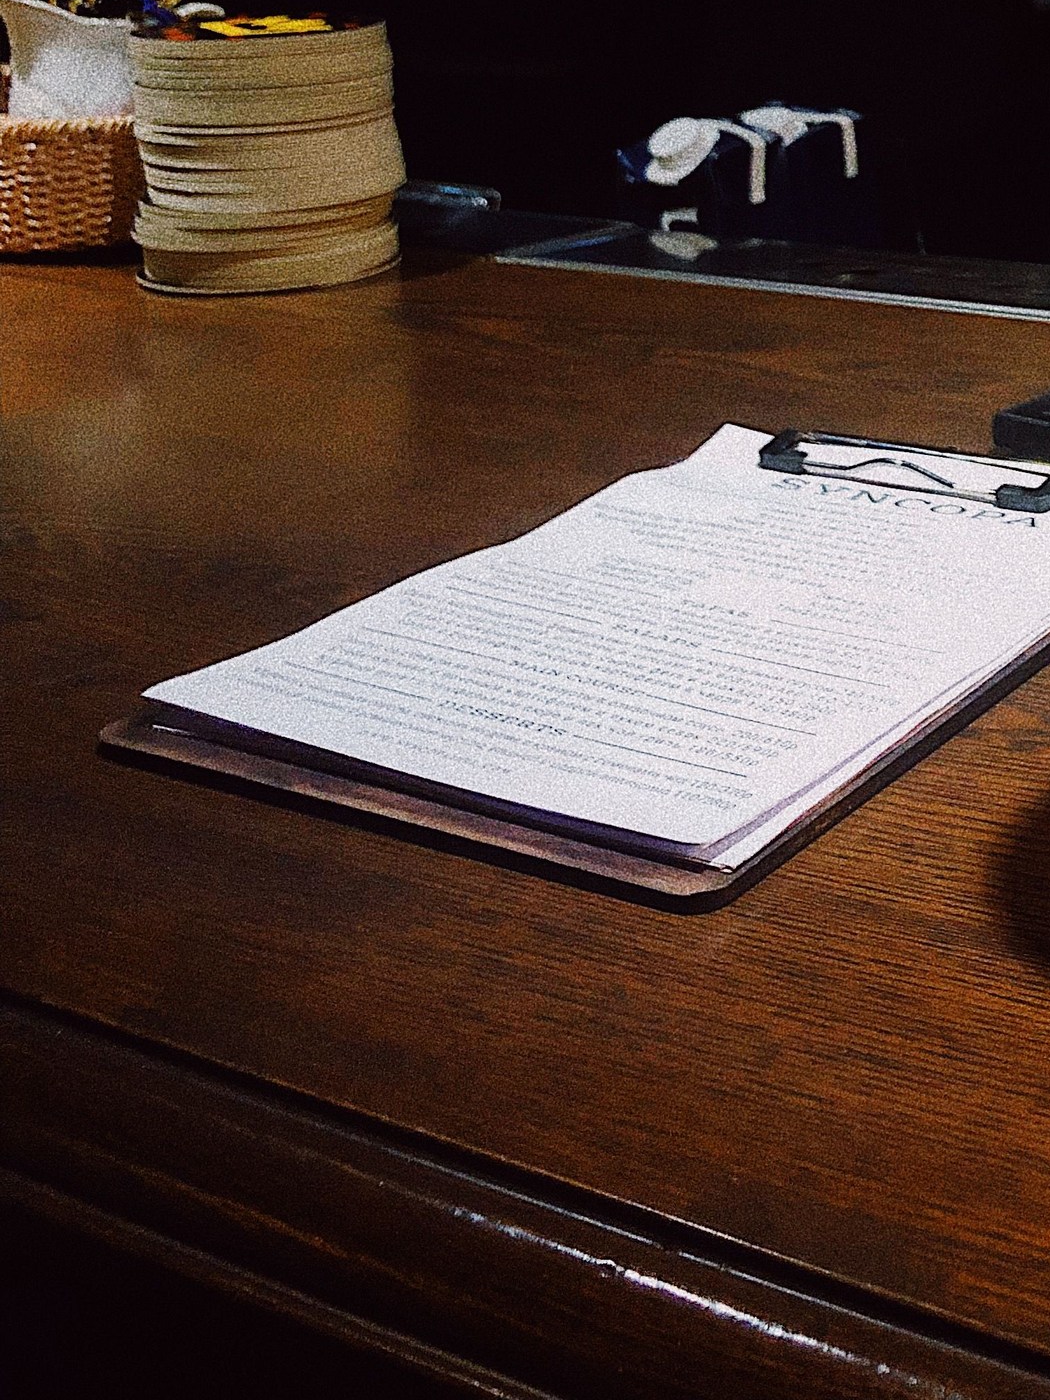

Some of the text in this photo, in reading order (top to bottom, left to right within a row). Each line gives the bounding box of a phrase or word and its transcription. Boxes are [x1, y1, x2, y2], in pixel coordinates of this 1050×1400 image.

[771, 476, 1040, 528] SYNCOPA
[678, 598, 752, 618] TAPAS
[609, 623, 704, 648] SALADS
[511, 662, 644, 696] MAIN COURSE
[438, 700, 566, 736] DESSERTS
